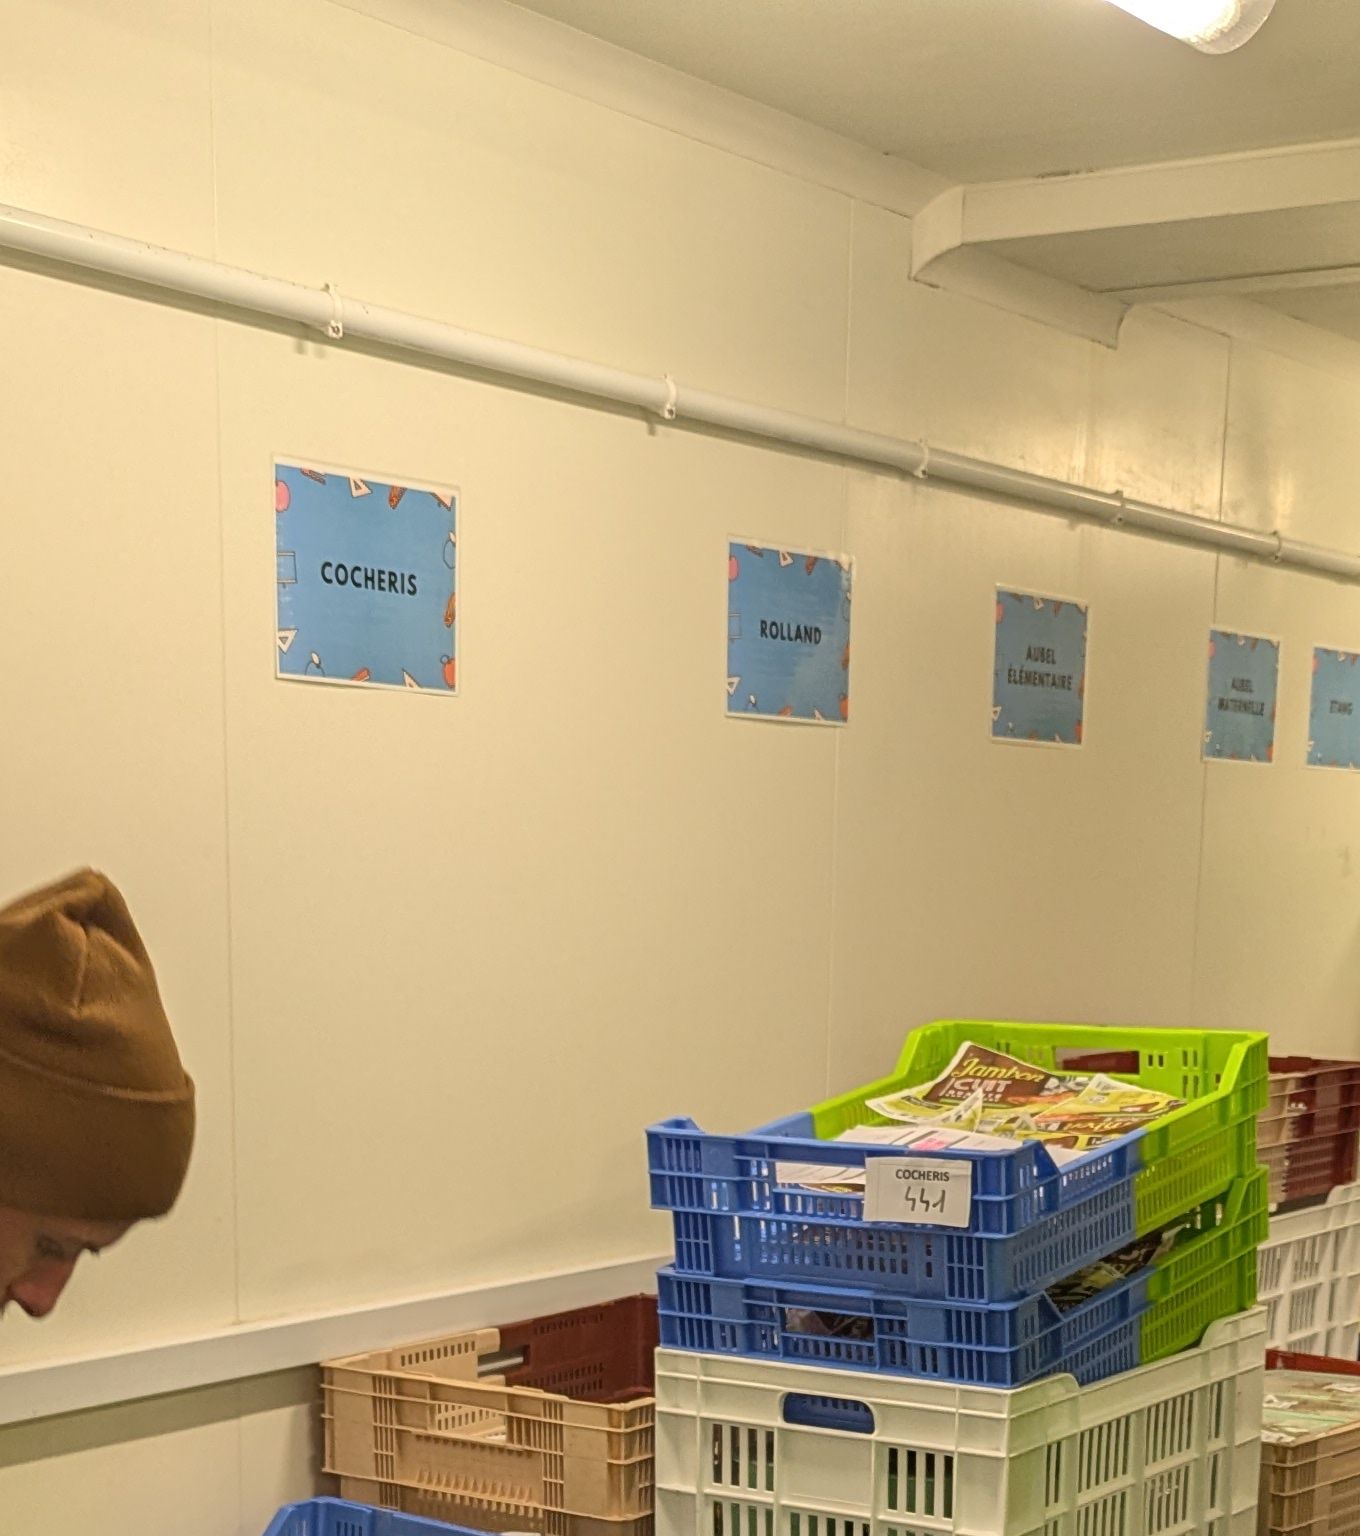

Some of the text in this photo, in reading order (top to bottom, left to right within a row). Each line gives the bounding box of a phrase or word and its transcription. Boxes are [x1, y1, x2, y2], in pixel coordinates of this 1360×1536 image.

[320, 560, 418, 596] COCHERIS
[759, 619, 822, 645] ROLLAND
[1026, 645, 1056, 664] AUBEL
[951, 1057, 1045, 1082] Jambon
[896, 1169, 950, 1181] COCHERIS
[904, 1186, 946, 1212] 441
